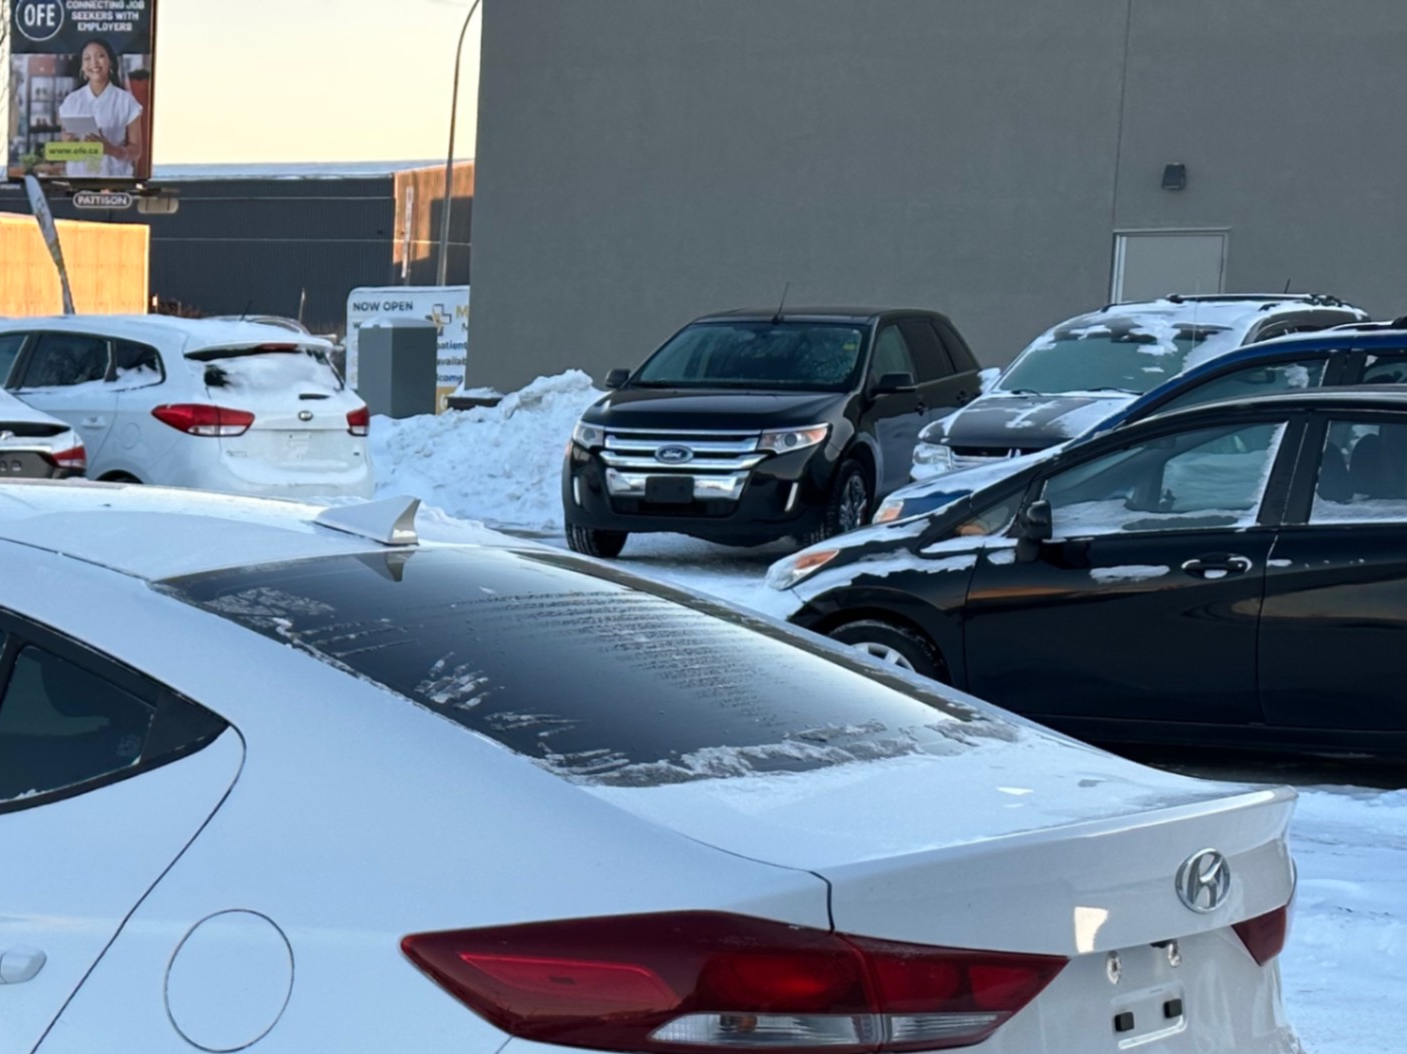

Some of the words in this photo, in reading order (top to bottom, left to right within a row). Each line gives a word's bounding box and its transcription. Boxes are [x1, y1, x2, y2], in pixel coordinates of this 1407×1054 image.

[66, 0, 124, 10] CONNECTING
[126, 1, 145, 10] JOB
[24, 3, 55, 26] OFE
[71, 11, 114, 21] SEEKERS
[115, 11, 139, 21] WITH
[77, 22, 133, 32] EMPLOYERS
[77, 195, 128, 205] PATTISON
[353, 301, 380, 312] NOW
[383, 301, 413, 311] OPEN
